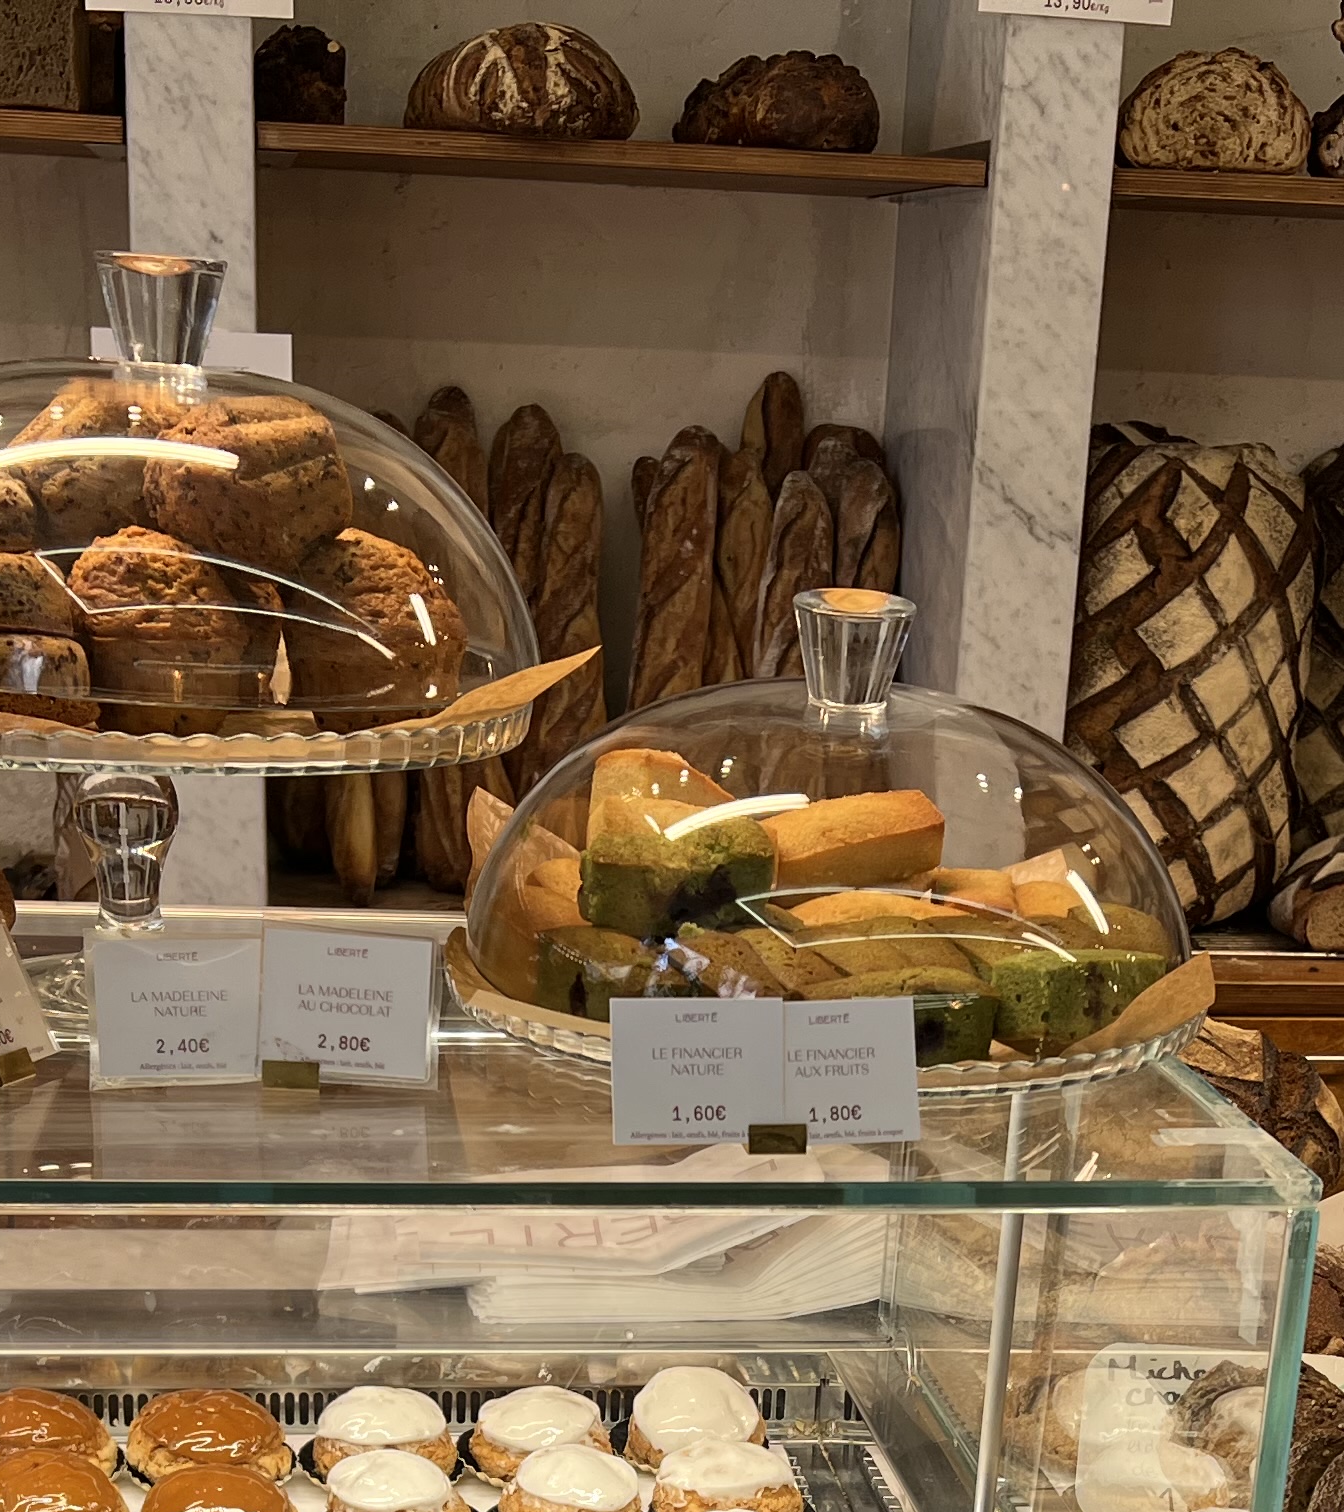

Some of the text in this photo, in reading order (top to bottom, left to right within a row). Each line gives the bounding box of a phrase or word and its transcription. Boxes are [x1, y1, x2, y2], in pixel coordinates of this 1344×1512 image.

[131, 989, 229, 1003] LA MADELEINE
[298, 984, 394, 1003] LA MADELEINE
[154, 1006, 208, 1018] NATURE
[298, 1000, 392, 1018] AU CHOCOLAT
[156, 1038, 210, 1056] 2,40€
[317, 1034, 371, 1052] 2,80€
[651, 1047, 743, 1061] LE FINANCIER
[787, 1047, 876, 1063] LE FINANCIER
[670, 1063, 725, 1076] NATURE
[794, 1063, 870, 1078] AUX FRUITS
[672, 1105, 726, 1124] 1,60€
[808, 1105, 862, 1124] 1,80€
